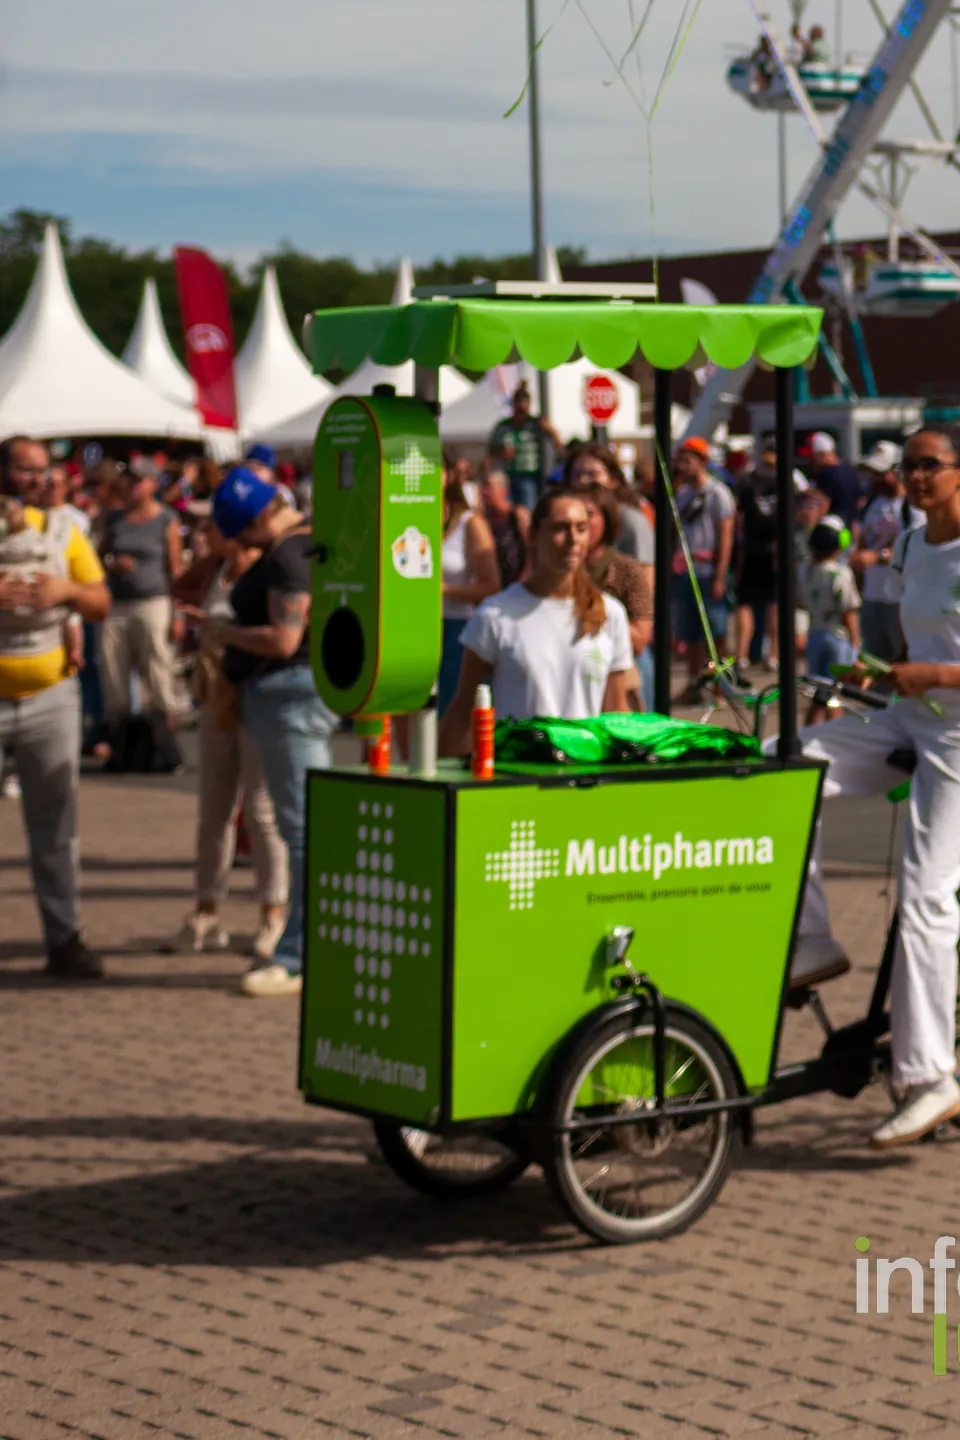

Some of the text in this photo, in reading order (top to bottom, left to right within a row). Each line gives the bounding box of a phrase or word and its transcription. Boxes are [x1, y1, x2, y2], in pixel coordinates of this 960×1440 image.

[585, 388, 617, 409] STOP
[565, 831, 774, 880] Multipharma
[315, 1036, 427, 1092] Multipharma
